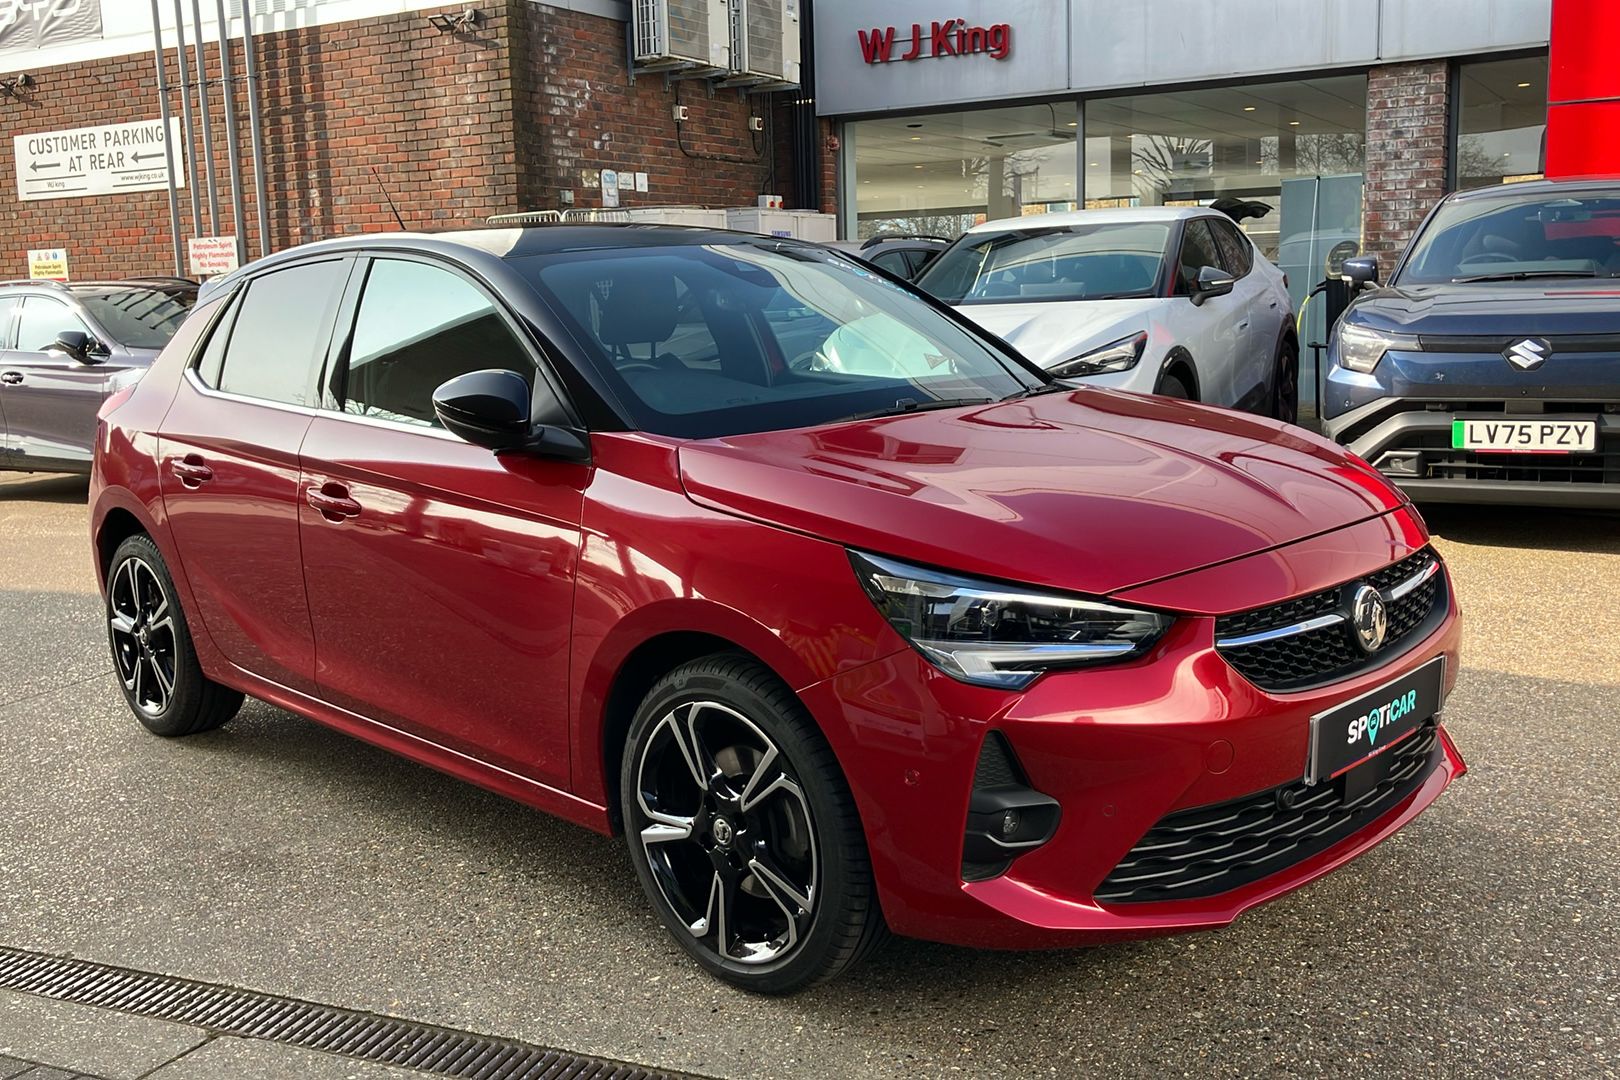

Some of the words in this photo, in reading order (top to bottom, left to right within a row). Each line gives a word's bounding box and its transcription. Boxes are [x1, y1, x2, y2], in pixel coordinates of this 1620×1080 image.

[857, 26, 895, 65] W
[902, 24, 921, 61] J
[931, 18, 1010, 60] King
[28, 133, 97, 156] CUSTOMER
[104, 125, 164, 148] PARKING
[68, 156, 83, 172] AT
[90, 152, 125, 170] REAR
[121, 172, 164, 182] www.wjking.co.uk
[219, 241, 232, 249] Spirit
[192, 252, 207, 260] Highly
[1469, 424, 1532, 444] LV75
[1539, 424, 1588, 445] PZY
